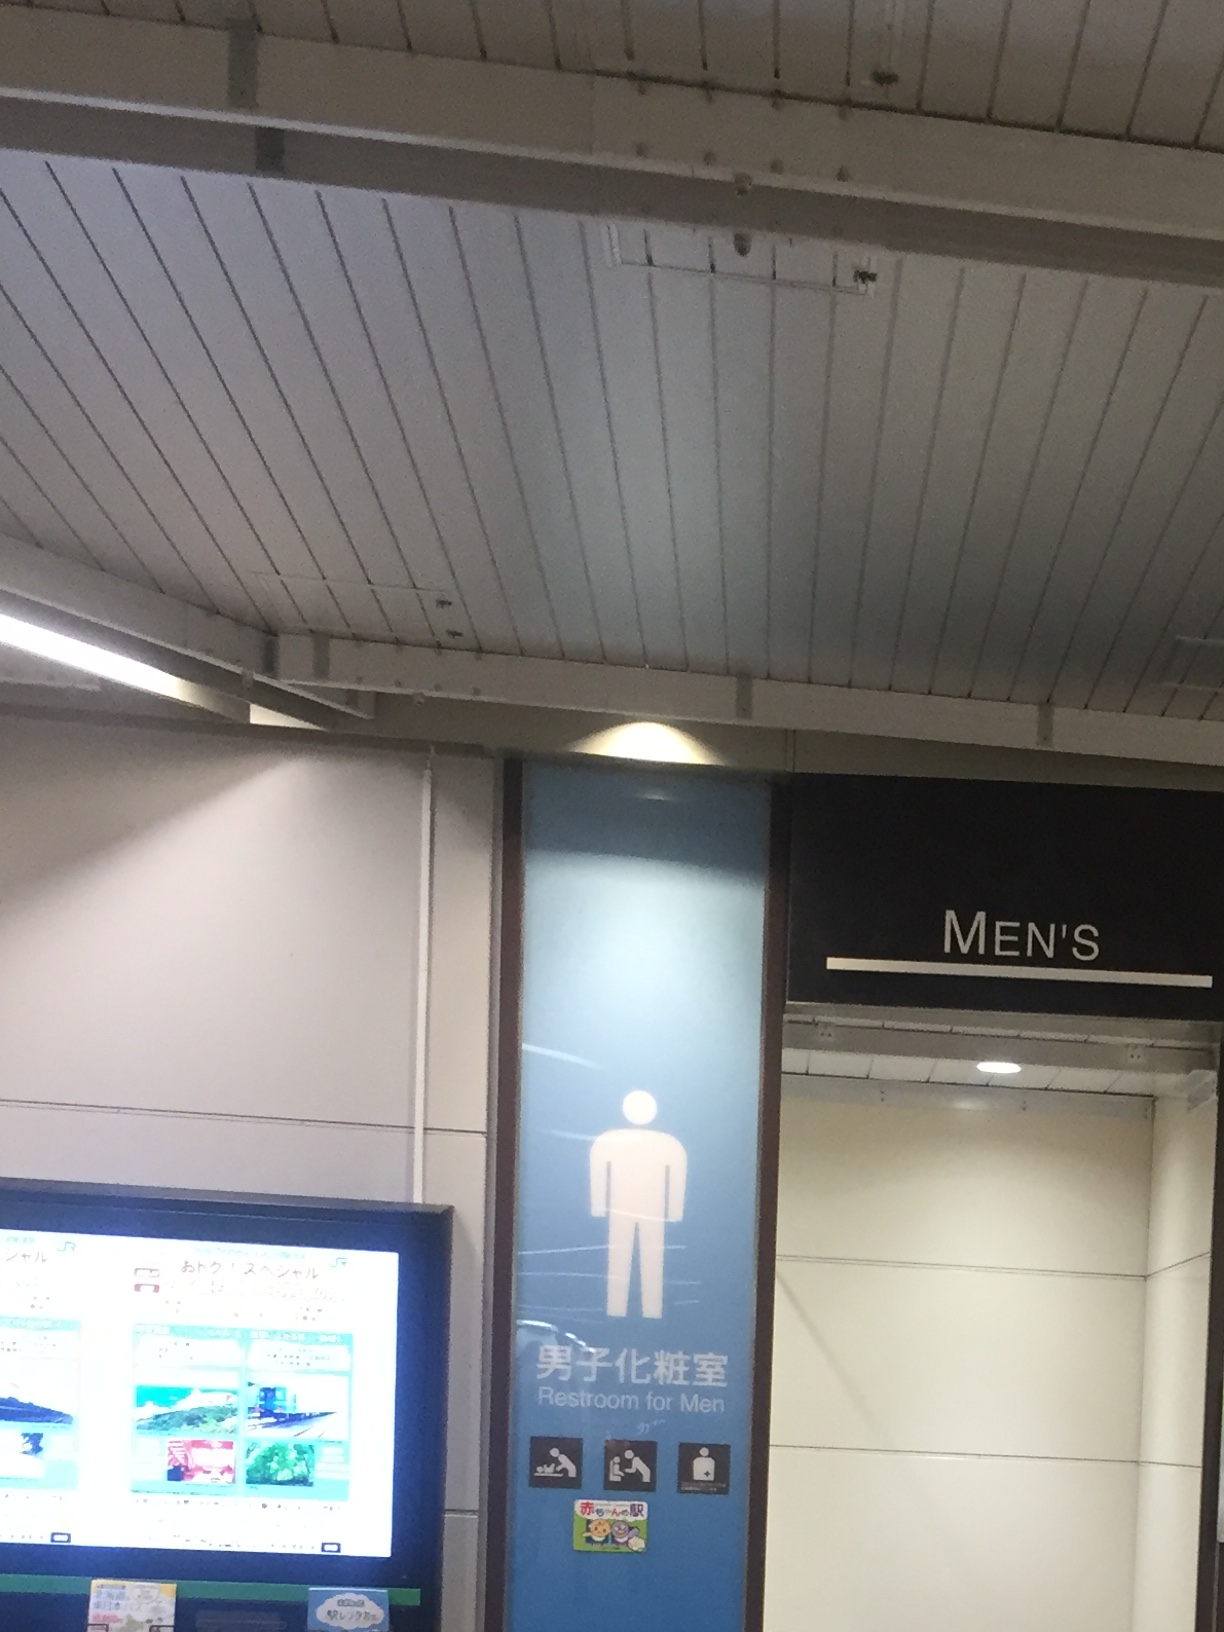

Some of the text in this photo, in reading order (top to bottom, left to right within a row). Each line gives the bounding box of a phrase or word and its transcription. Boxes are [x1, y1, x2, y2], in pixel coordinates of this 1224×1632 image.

[536, 1344, 729, 1388] 男子化粧室
[537, 1386, 726, 1413] Restroom for Men
